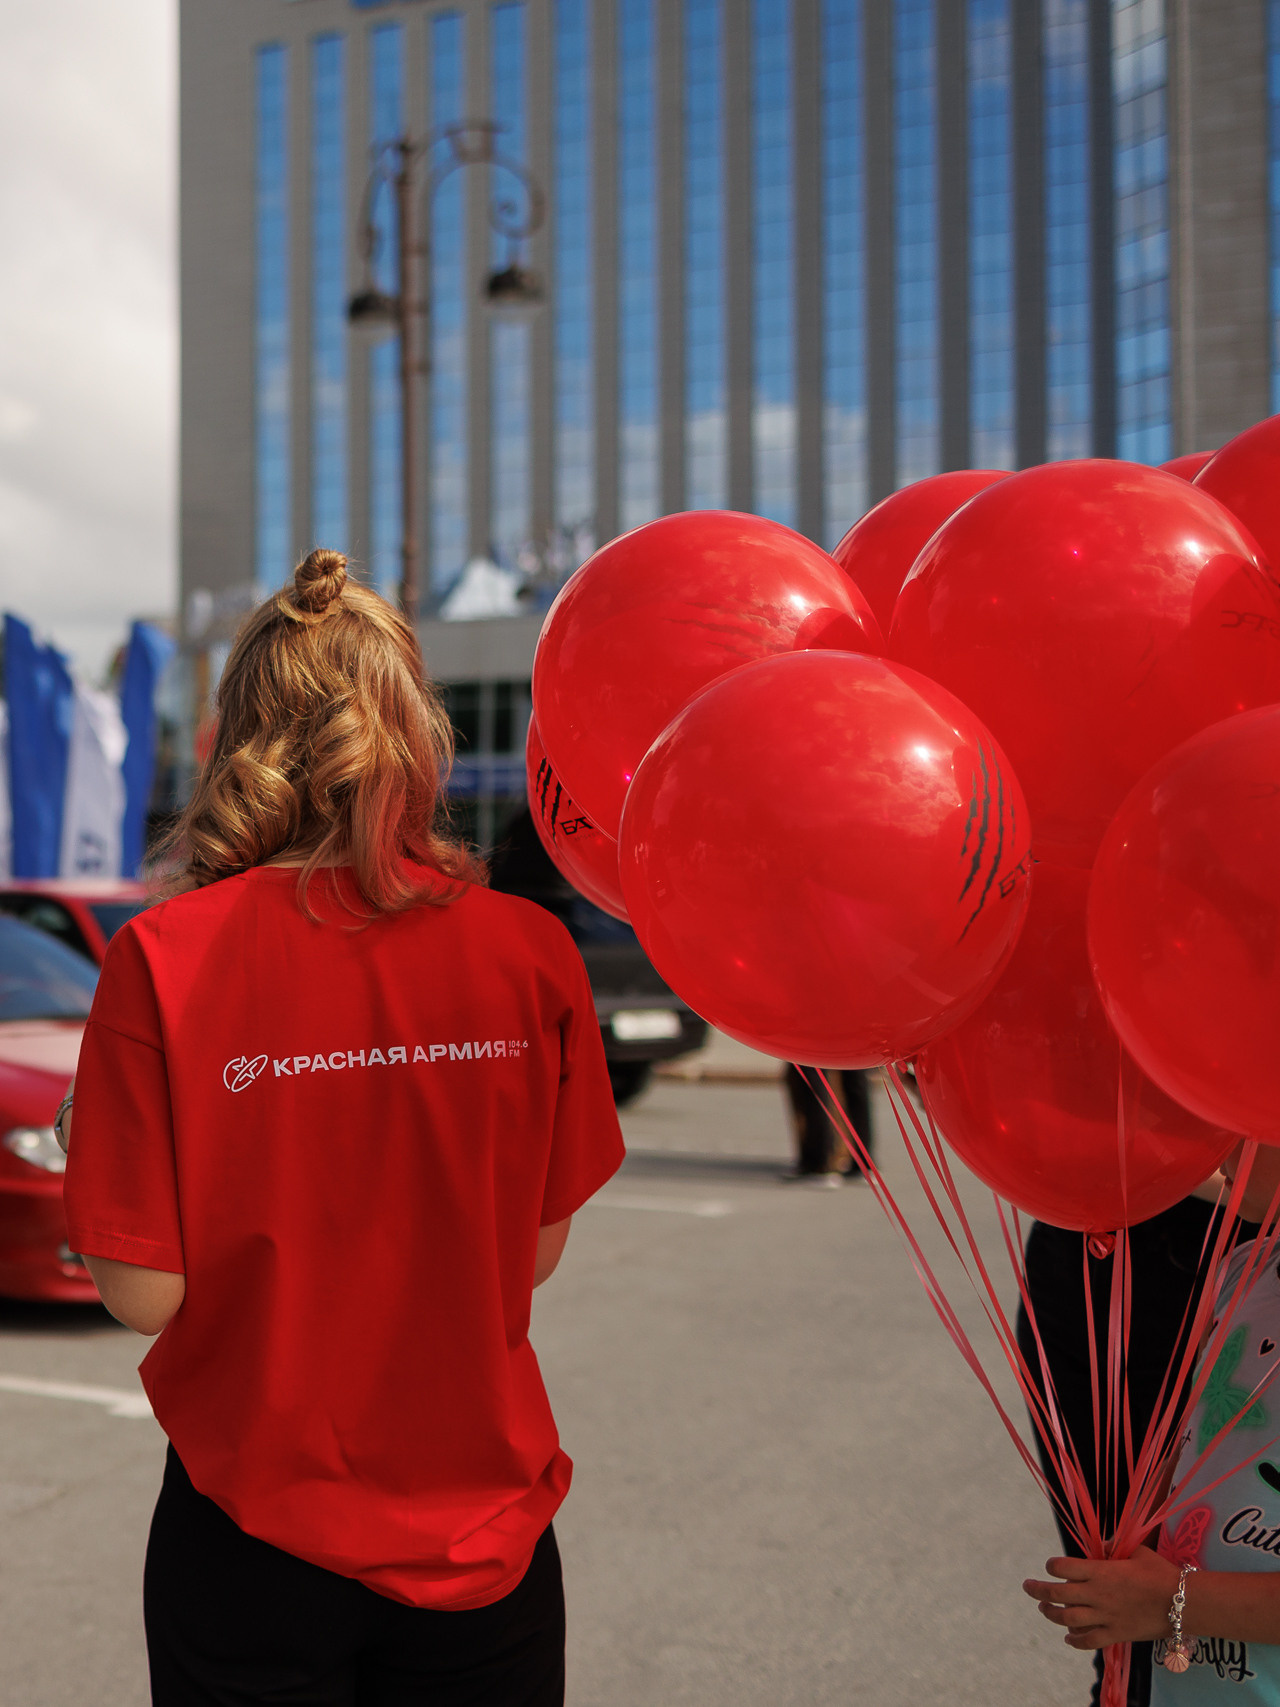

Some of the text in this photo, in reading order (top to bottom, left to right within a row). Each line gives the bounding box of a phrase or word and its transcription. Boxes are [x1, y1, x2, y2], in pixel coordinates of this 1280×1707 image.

[508, 1039, 529, 1049] 104.6
[273, 1040, 507, 1077] КРАСНАЯ АРМИЯ
[509, 1049, 521, 1058] FM
